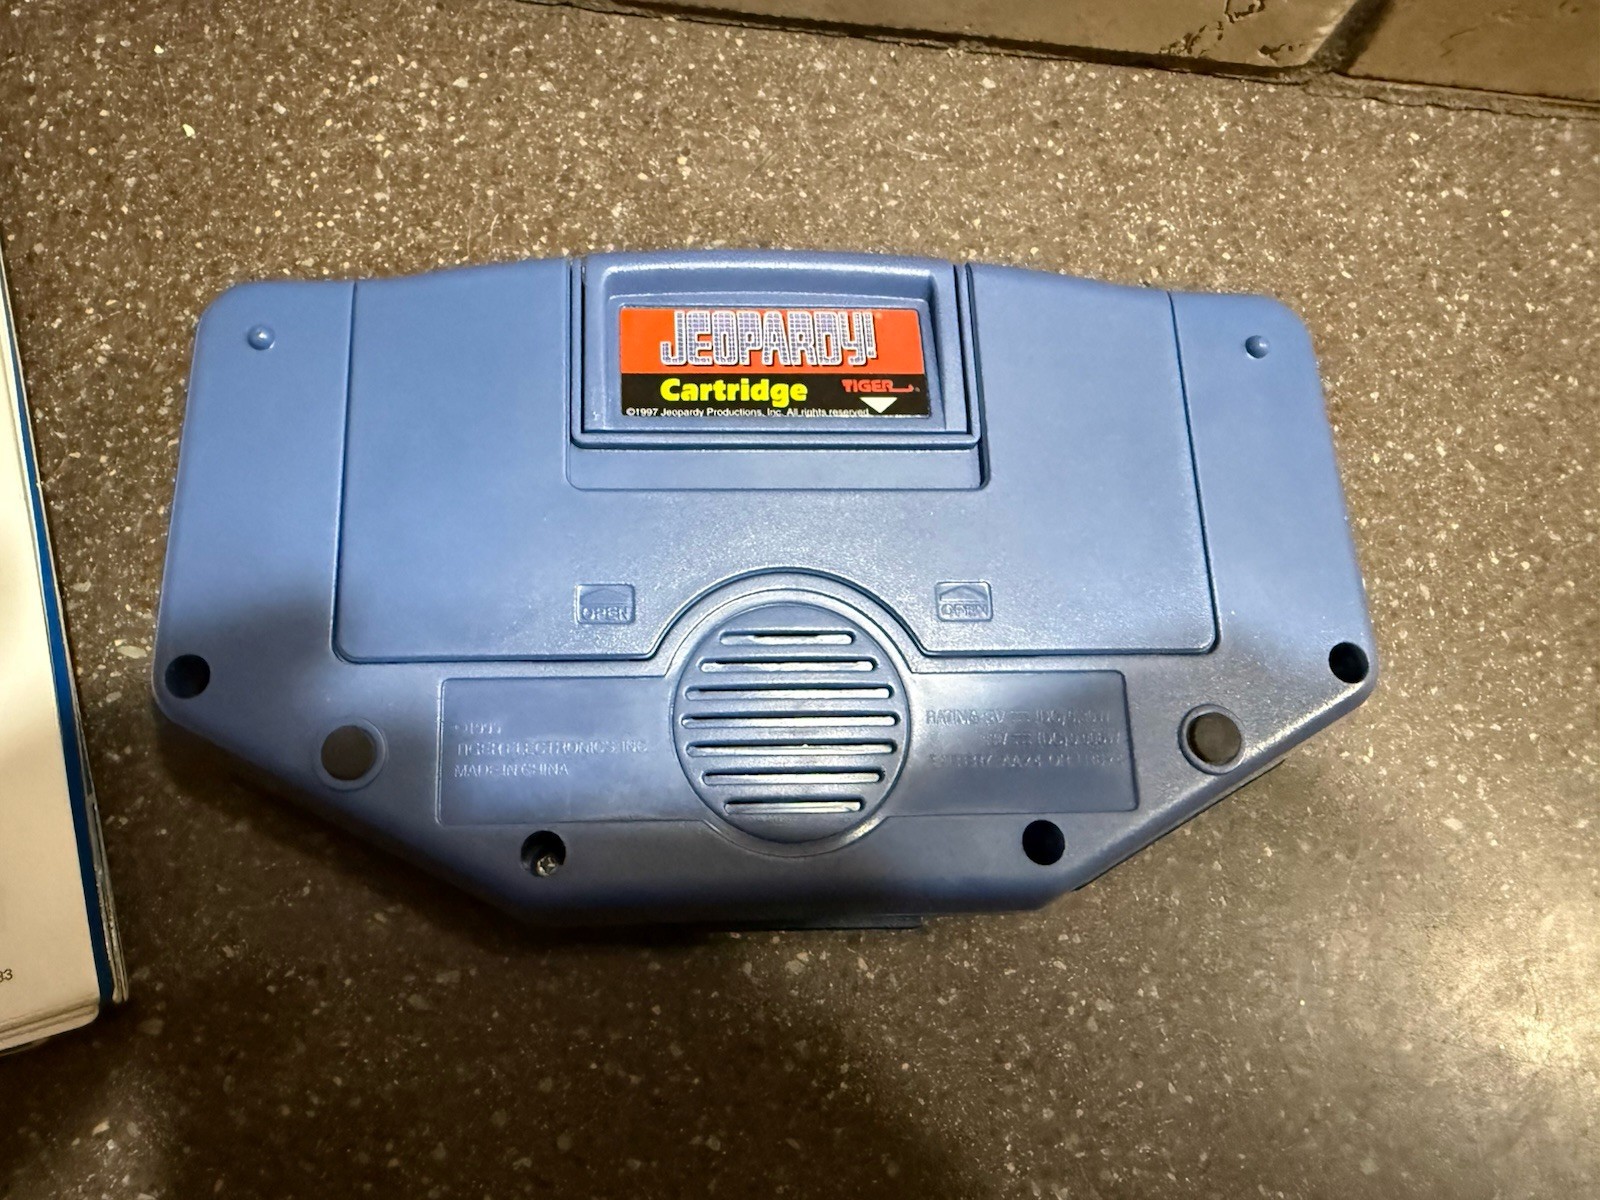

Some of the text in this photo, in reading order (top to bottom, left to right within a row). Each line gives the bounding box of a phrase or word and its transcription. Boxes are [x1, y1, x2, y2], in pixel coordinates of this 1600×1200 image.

[660, 310, 877, 365] JEOPARDY!
[660, 378, 808, 408] Cartridge
[841, 379, 914, 393] TIGER
[626, 407, 658, 416] ©1997
[660, 407, 703, 417] Jeopardy
[786, 408, 799, 417] All
[801, 408, 826, 418] rights
[582, 607, 631, 621] OPEN
[940, 603, 988, 618] OPEN
[501, 764, 518, 777] IN
[520, 763, 569, 777] CHINA
